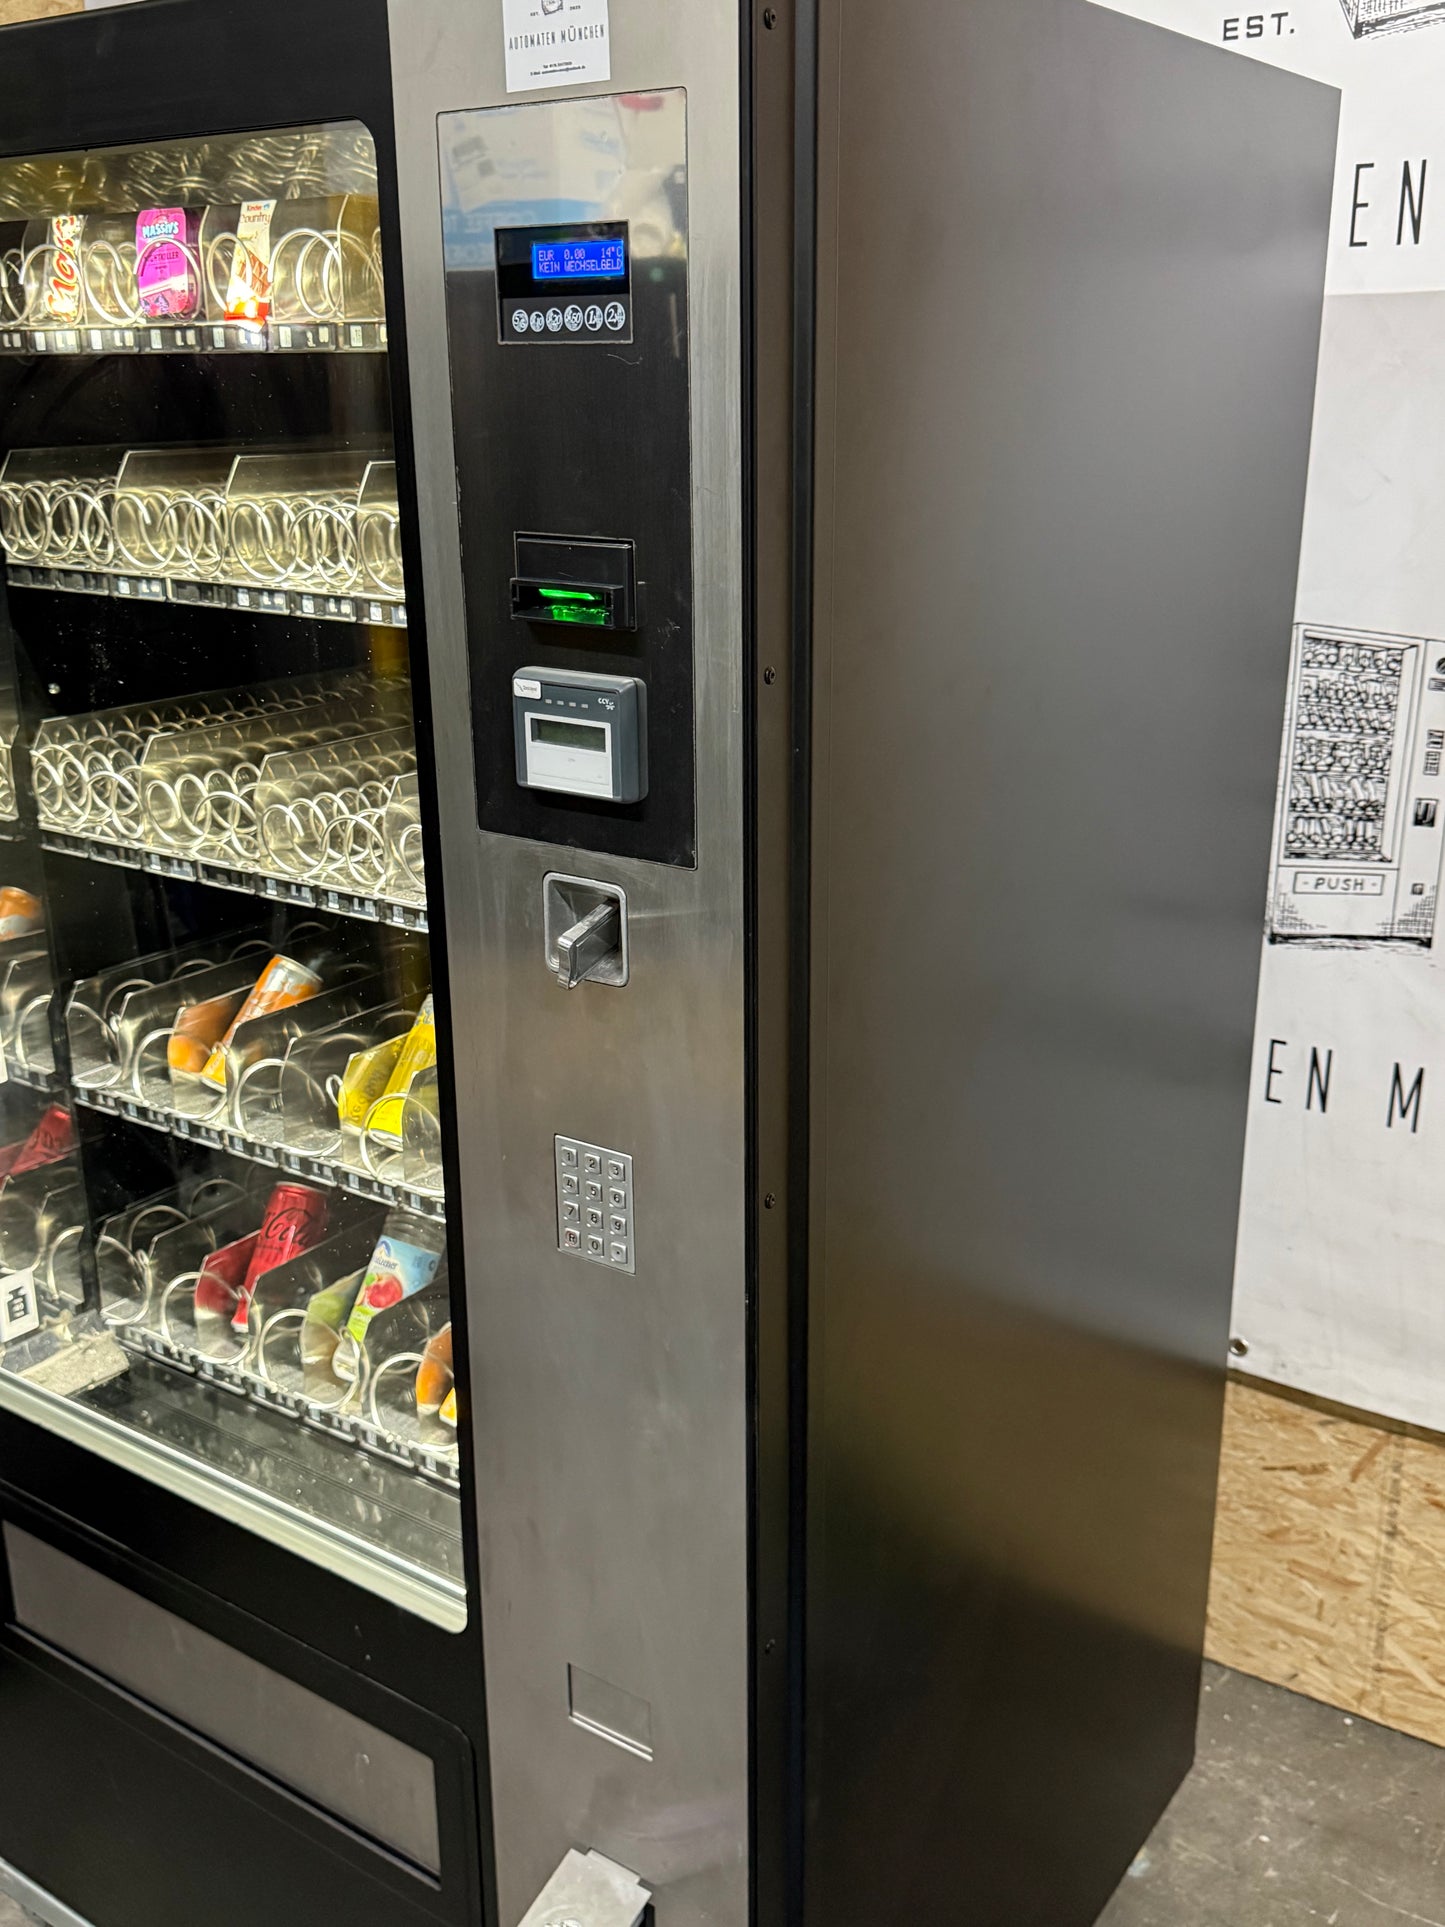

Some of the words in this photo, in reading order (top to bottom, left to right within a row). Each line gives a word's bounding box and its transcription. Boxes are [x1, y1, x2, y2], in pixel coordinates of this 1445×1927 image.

[1223, 12, 1295, 41] EST.
[509, 31, 556, 50] AUTOMATEN
[561, 24, 605, 42] MÜNCHEN
[538, 249, 554, 262] EUR
[563, 248, 585, 260] 0.00
[601, 246, 623, 259] 14°C
[538, 260, 560, 273] KEIN
[564, 258, 623, 273] WECHSELGELD
[1313, 876, 1364, 892] PUSH
